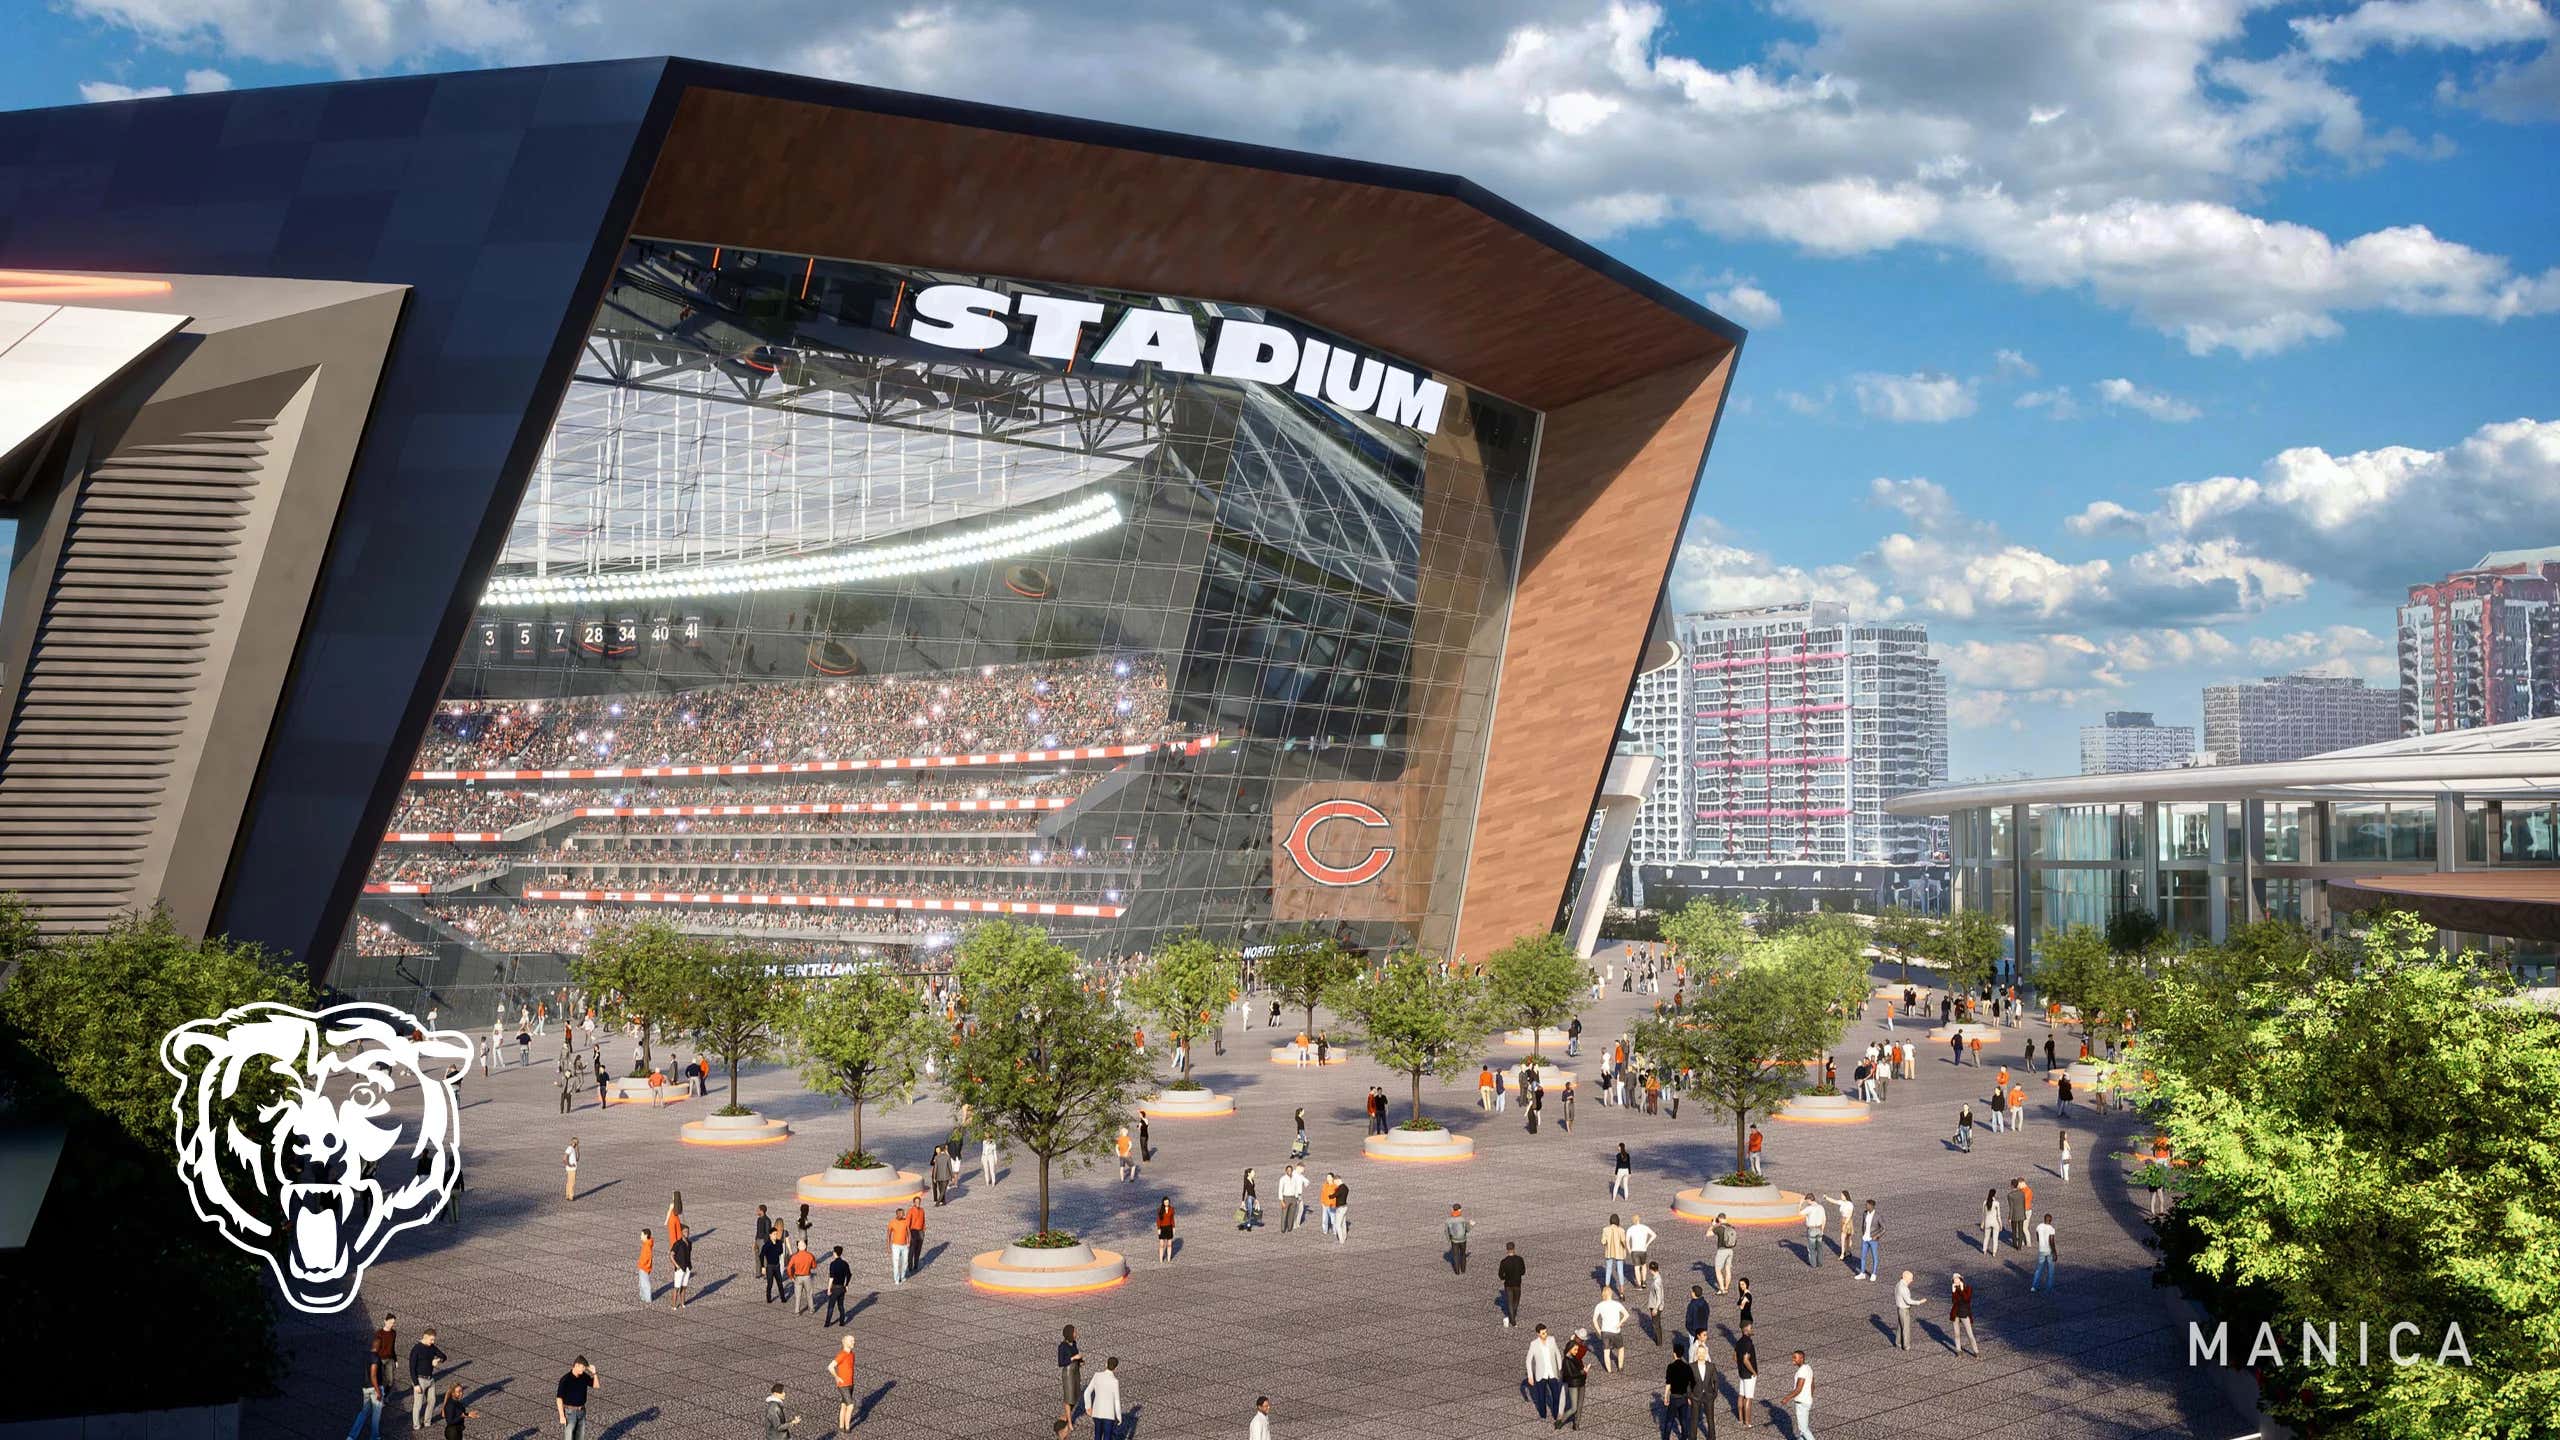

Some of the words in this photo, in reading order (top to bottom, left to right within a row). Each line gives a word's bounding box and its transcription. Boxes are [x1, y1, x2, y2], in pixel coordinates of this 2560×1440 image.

[909, 284, 1448, 435] STADIUM
[485, 630, 495, 646] 3
[520, 629, 530, 645] 5
[555, 628, 565, 644] 7
[584, 627, 603, 643] 28
[618, 626, 637, 641] 34
[651, 625, 669, 641] 40
[684, 622, 698, 639] 41
[1281, 799, 1394, 886] C
[1243, 945, 1276, 959] NORTH
